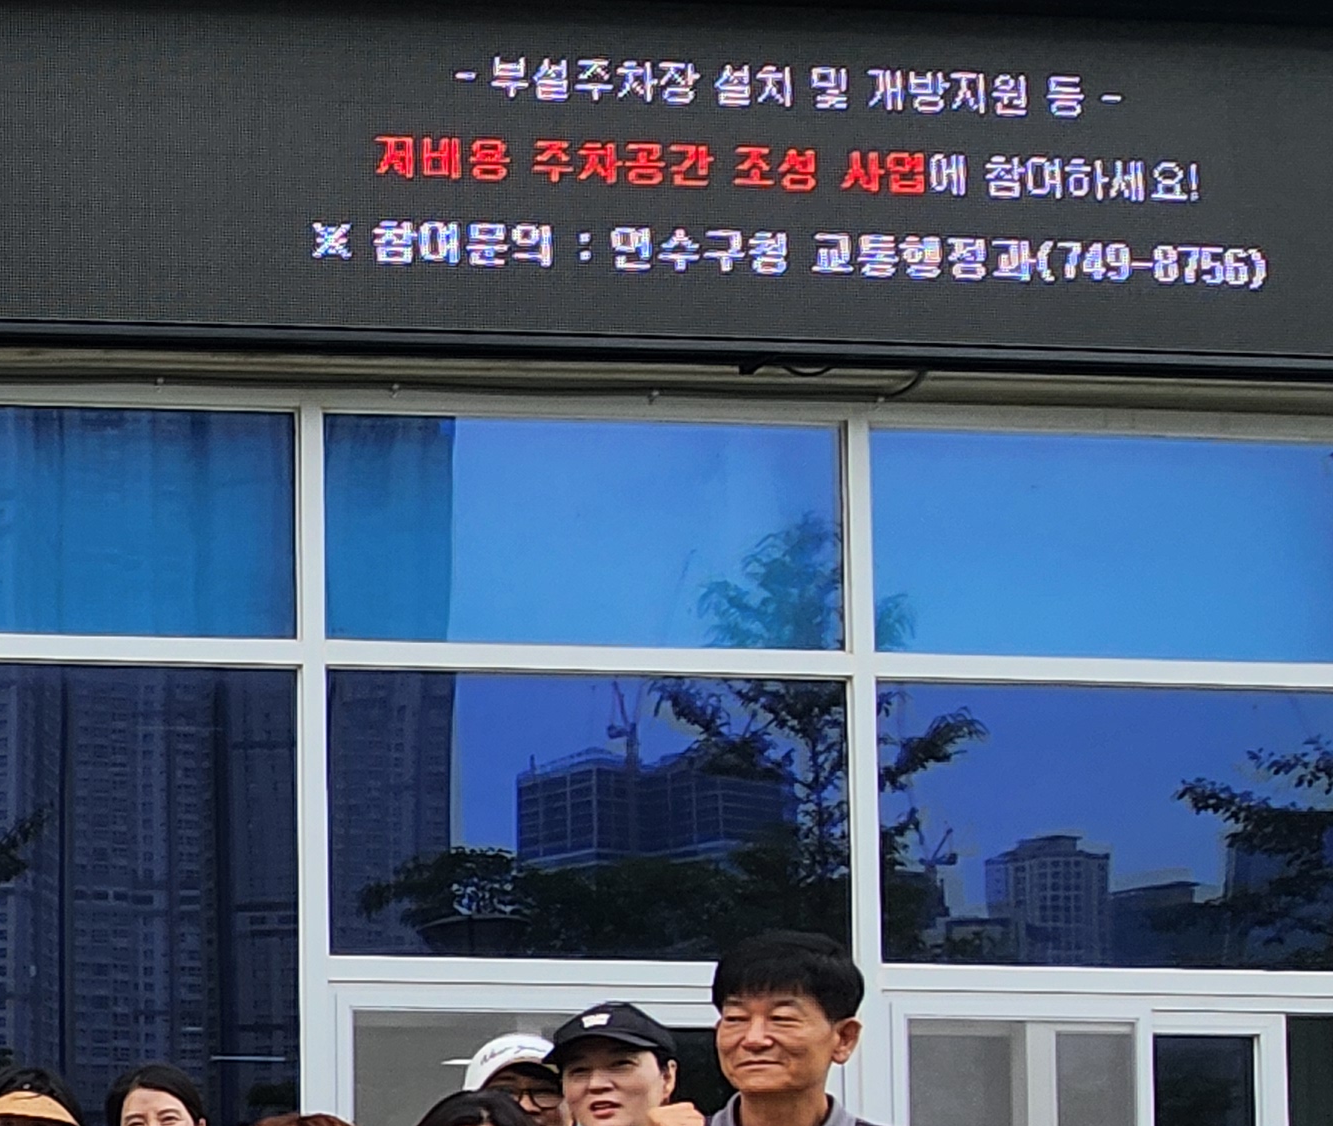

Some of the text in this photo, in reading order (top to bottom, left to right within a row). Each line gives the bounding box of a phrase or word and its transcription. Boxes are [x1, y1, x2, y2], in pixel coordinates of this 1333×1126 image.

[490, 55, 701, 106] 부설주차장
[714, 63, 792, 109] 설치
[810, 66, 848, 110] 및
[866, 69, 1027, 118] 개방지원
[1046, 76, 1085, 119] 등
[374, 134, 1200, 203] 저비용 주차공간 조성 사업에 참여하세요!
[371, 219, 554, 268] 참여문의
[610, 225, 789, 275] 연수구청
[810, 231, 1268, 290] 교통행정과(749-8756)
